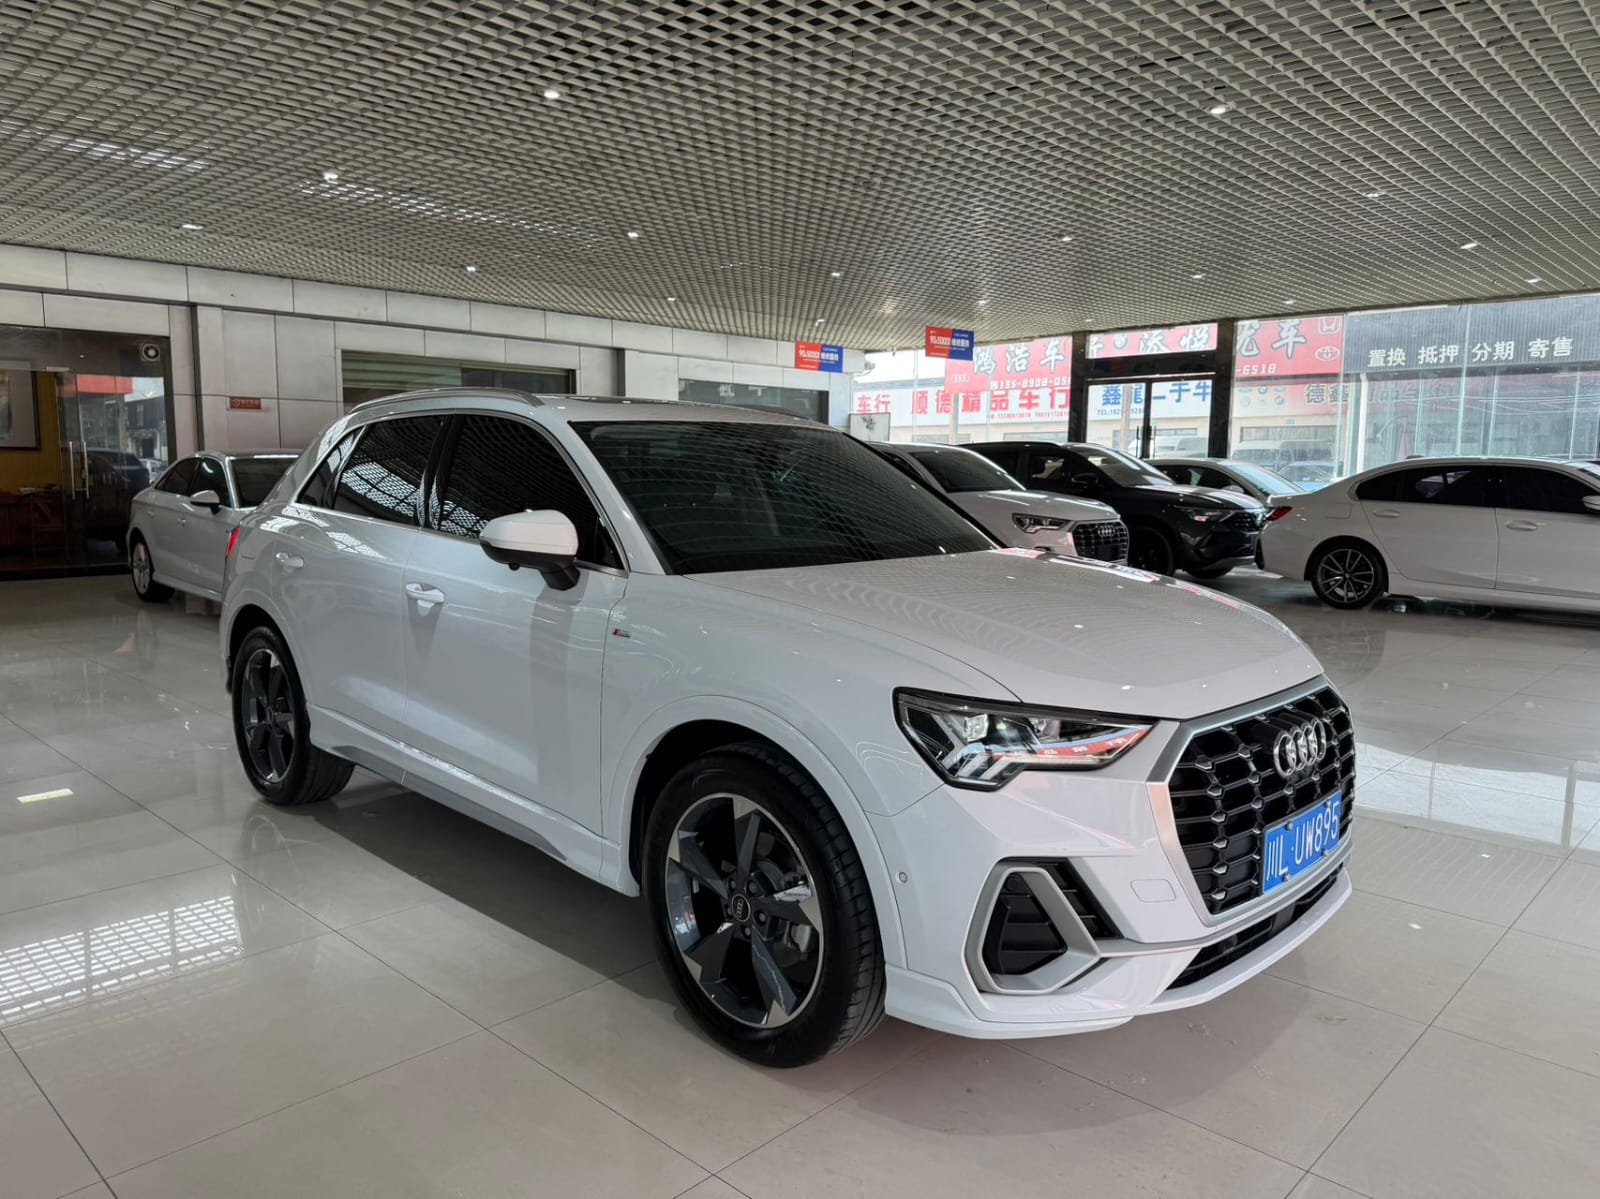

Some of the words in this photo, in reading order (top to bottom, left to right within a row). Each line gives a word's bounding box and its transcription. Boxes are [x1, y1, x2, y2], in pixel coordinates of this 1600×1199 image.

[1367, 347, 1406, 367] 置换
[1418, 344, 1459, 365] 抵押
[1471, 341, 1515, 362] 分期
[1527, 336, 1573, 359] 寄售
[857, 394, 891, 414] 车行
